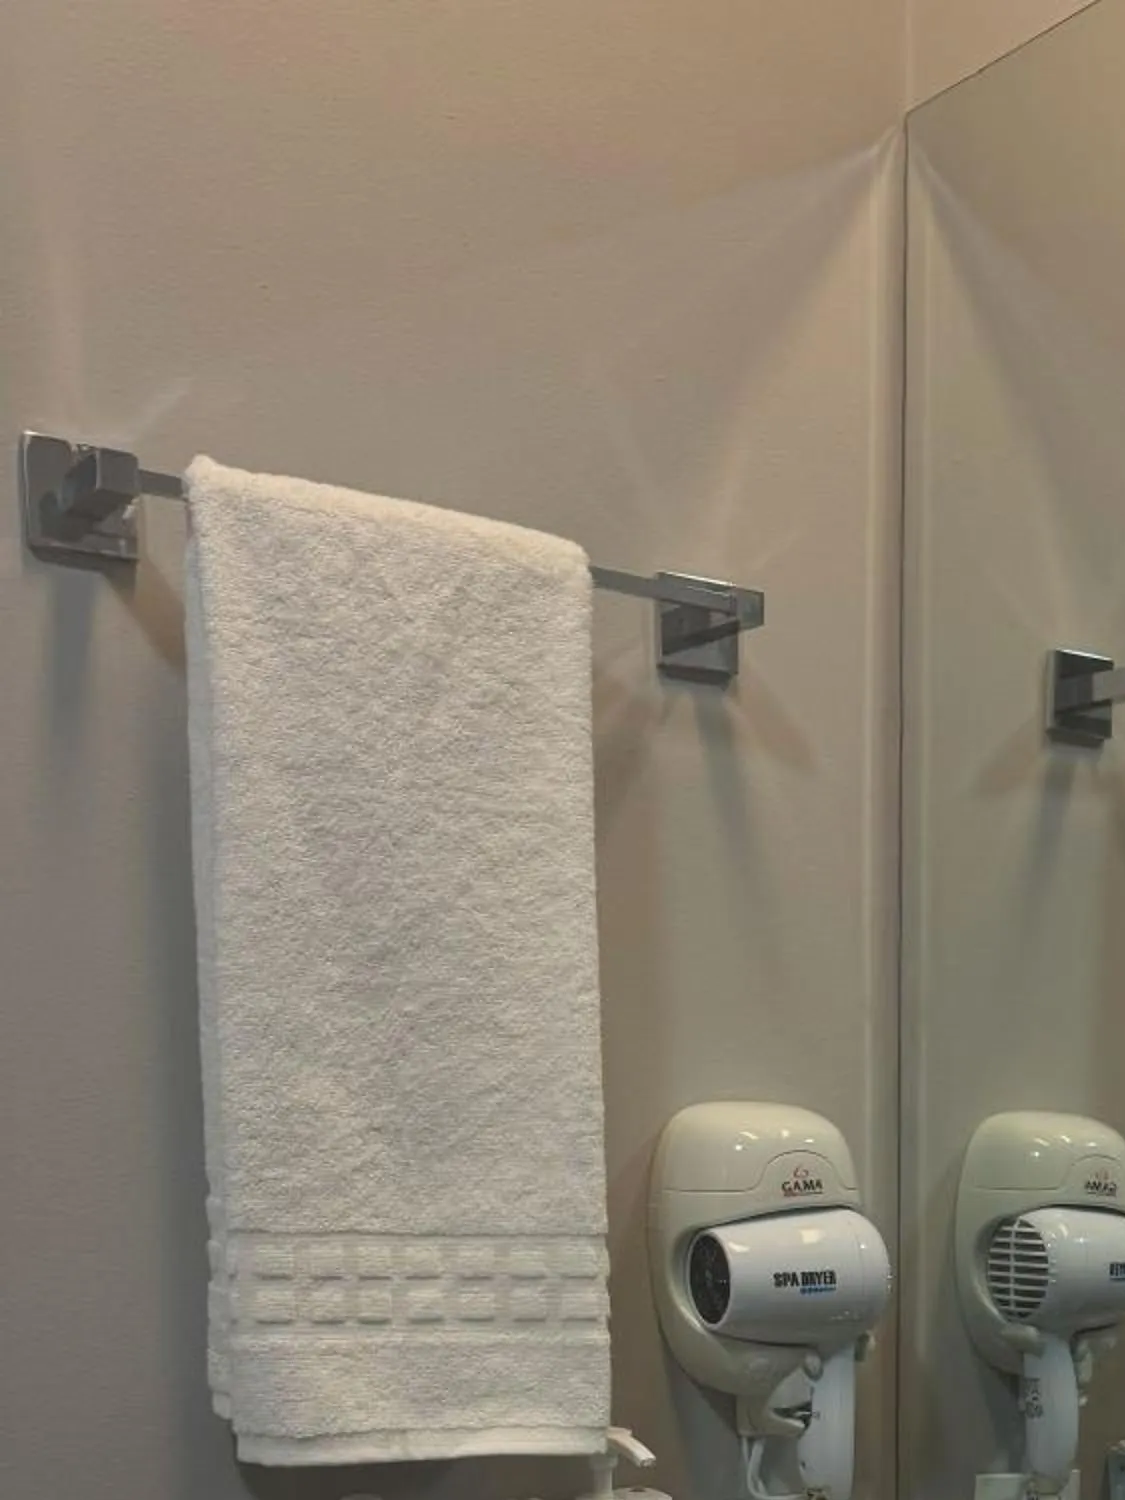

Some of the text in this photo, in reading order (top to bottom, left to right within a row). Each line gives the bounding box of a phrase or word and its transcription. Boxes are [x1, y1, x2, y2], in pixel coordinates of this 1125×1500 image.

[782, 1179, 823, 1191] GAMA
[773, 1270, 837, 1288] SPA DRYER
